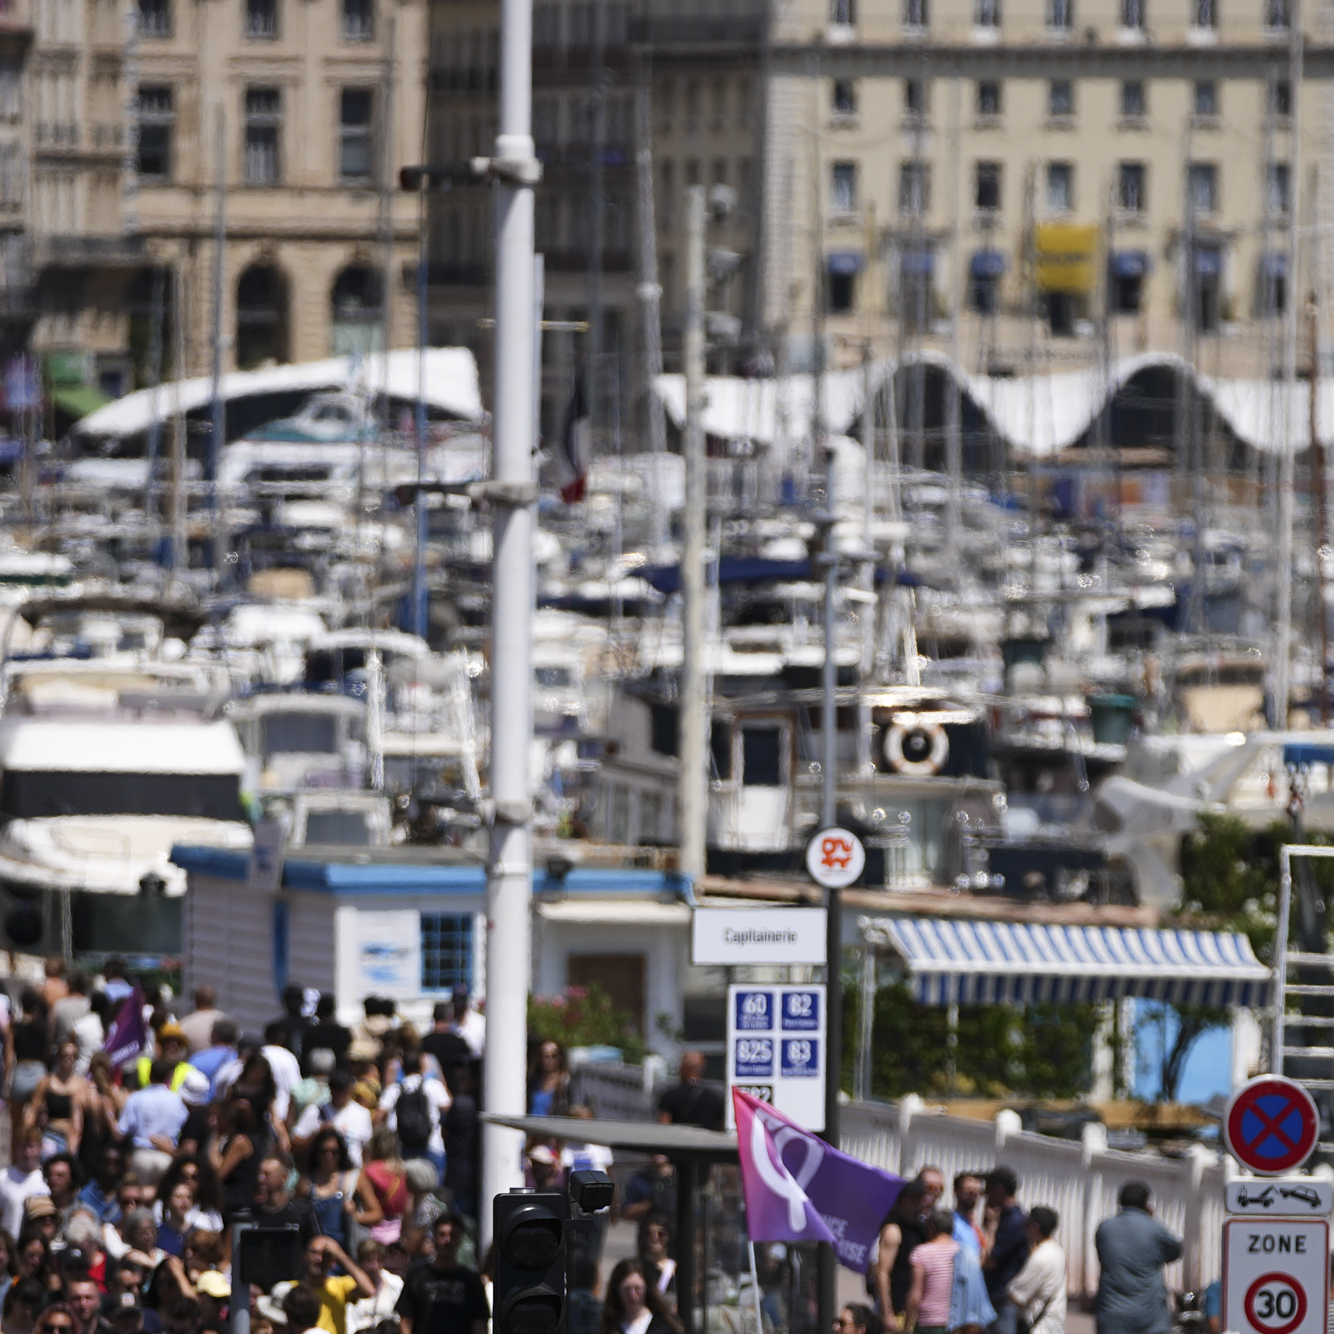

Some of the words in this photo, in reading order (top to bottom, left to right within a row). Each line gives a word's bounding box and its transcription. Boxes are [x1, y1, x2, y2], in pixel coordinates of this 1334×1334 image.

[724, 927, 798, 949] Capitainerie
[743, 994, 767, 1015] 60
[787, 994, 812, 1017] 82
[737, 1040, 772, 1063] 825
[787, 1040, 812, 1064] 83
[1248, 1233, 1307, 1254] ZONE
[1256, 1289, 1296, 1319] 30
